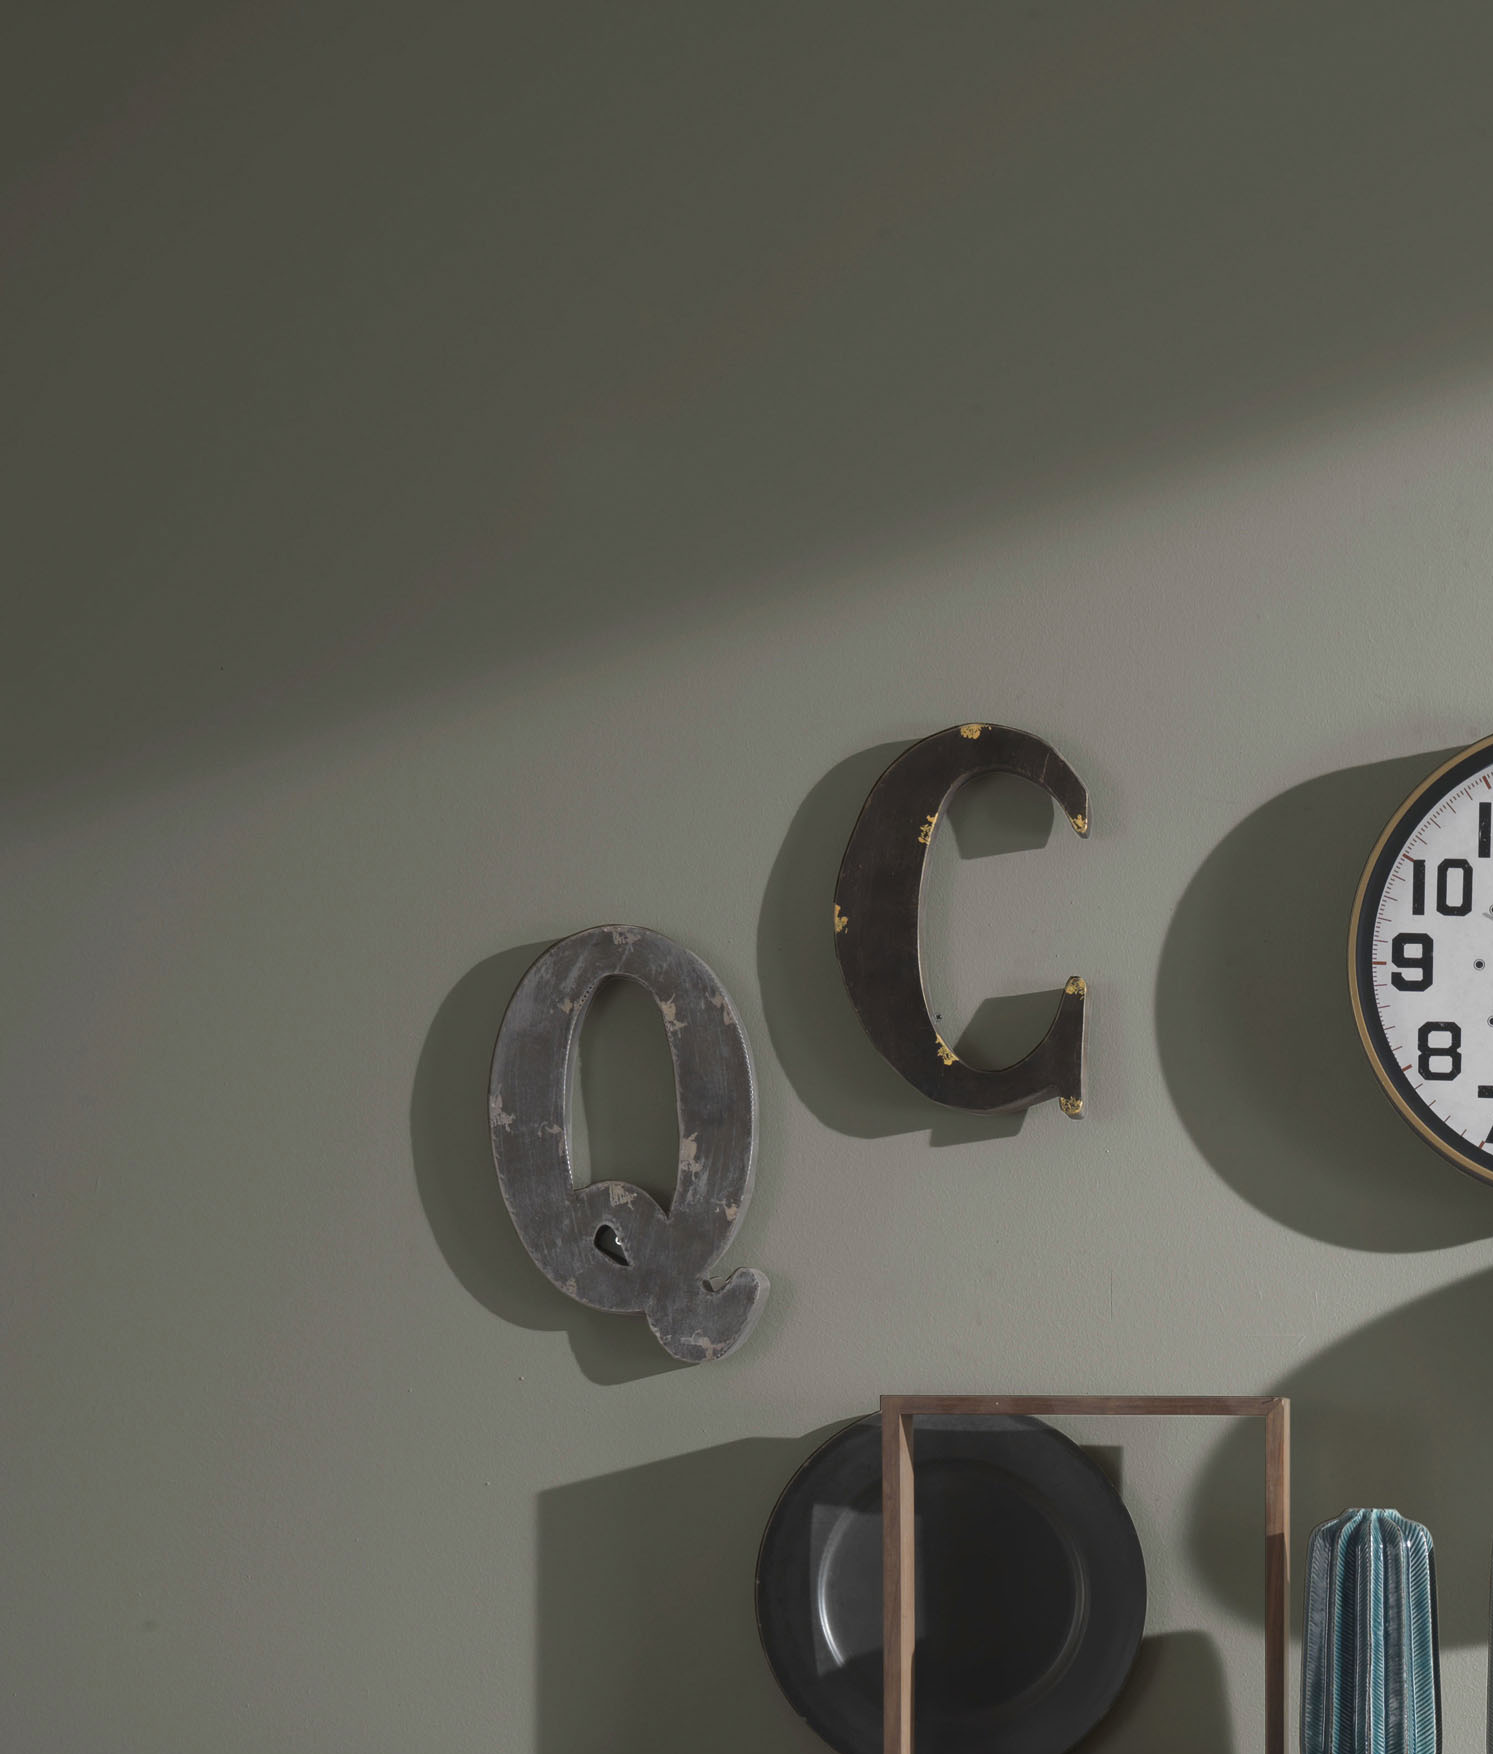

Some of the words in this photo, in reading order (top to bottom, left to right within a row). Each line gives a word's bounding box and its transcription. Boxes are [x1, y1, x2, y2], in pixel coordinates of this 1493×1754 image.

[1412, 858, 1473, 917] 10
[1391, 933, 1434, 992] 9
[1418, 1021, 1462, 1081] 8
[489, 923, 769, 1363] Q
